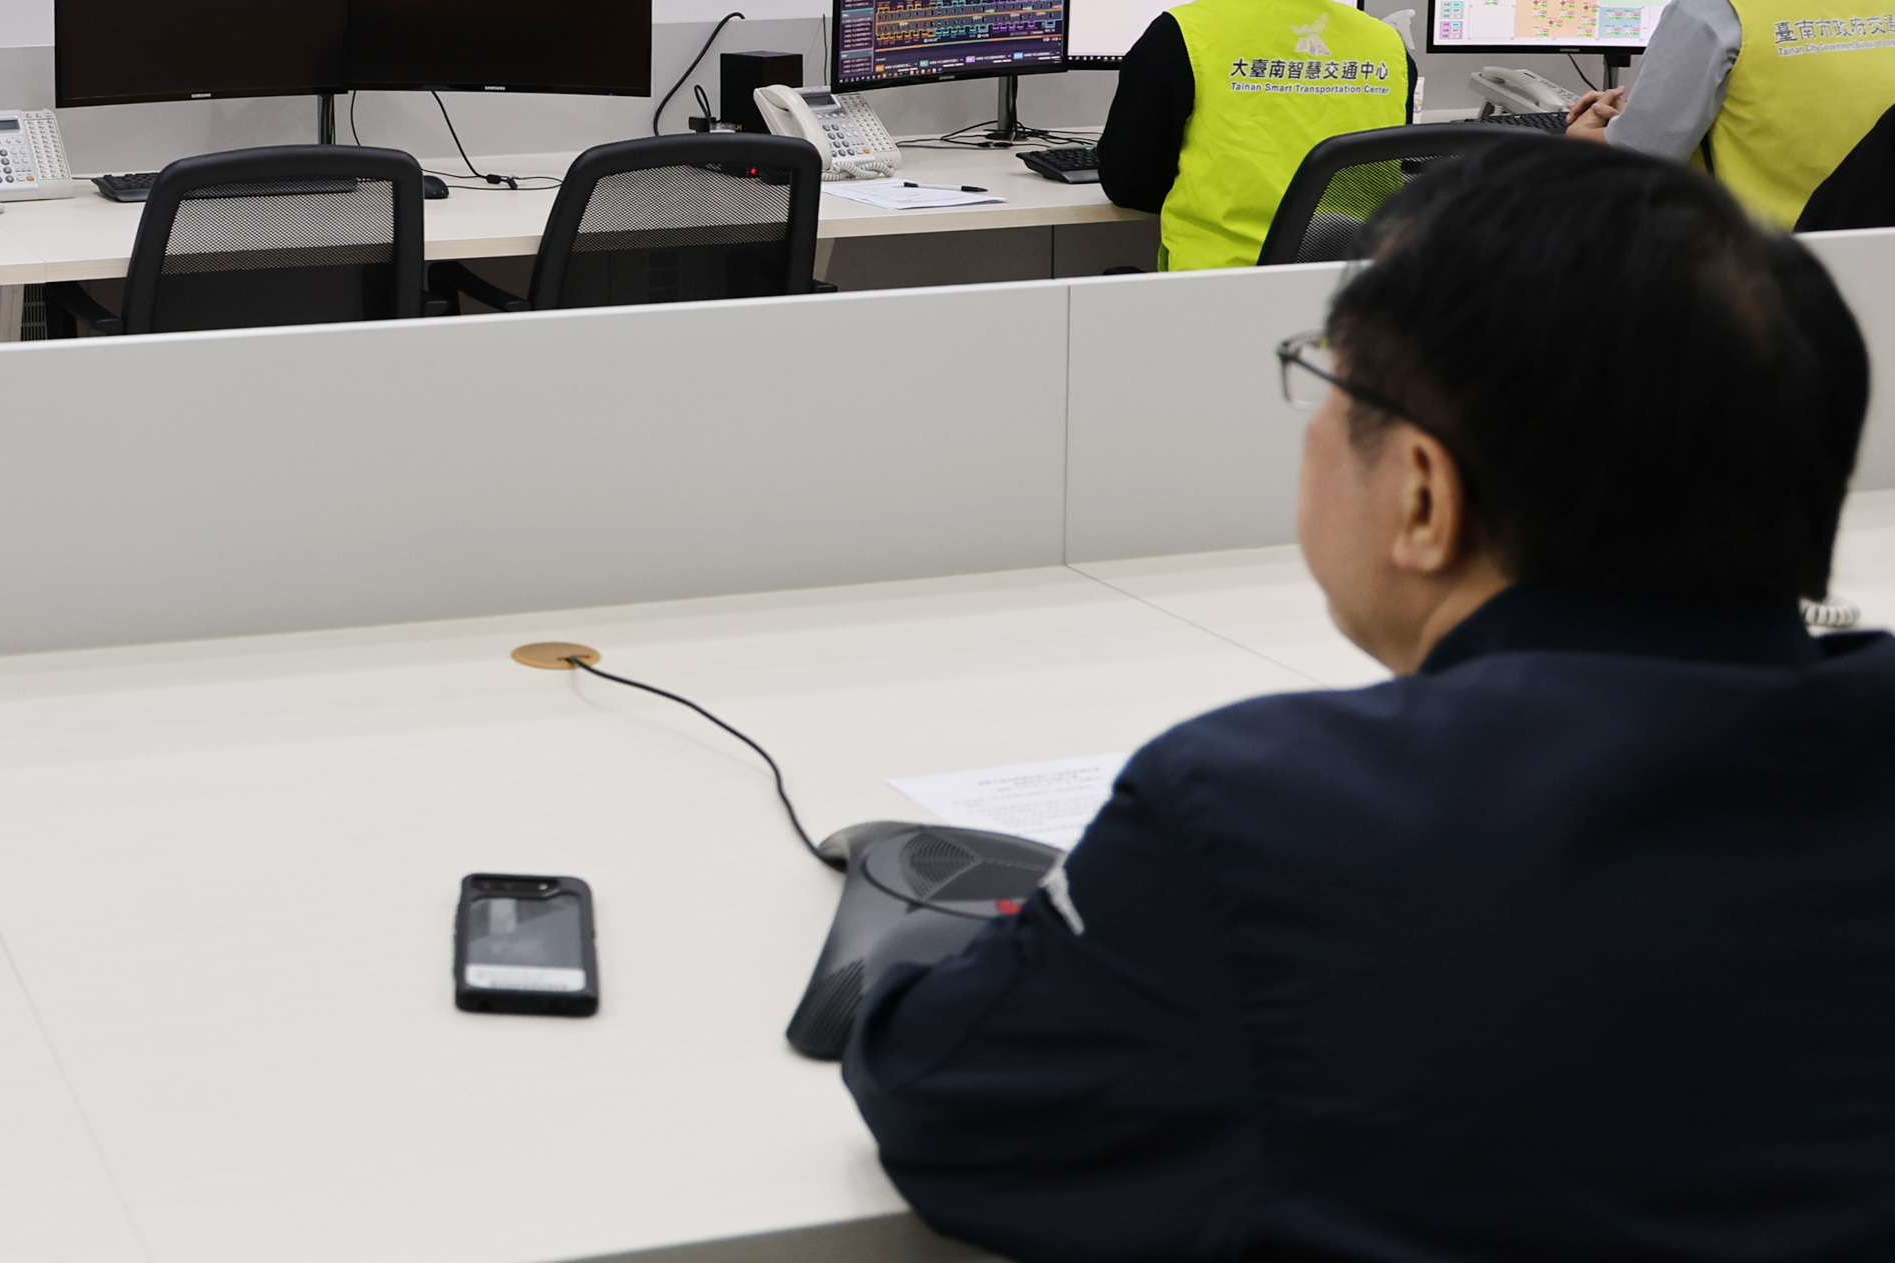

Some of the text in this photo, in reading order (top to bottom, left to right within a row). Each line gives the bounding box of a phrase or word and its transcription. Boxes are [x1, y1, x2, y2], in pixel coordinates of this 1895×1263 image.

[1778, 46, 1804, 56] Tainan
[1805, 43, 1819, 53] City
[1230, 59, 1388, 80] 大臺南智慧交通中心
[1232, 83, 1389, 94] Tainan Smart Transportation Center
